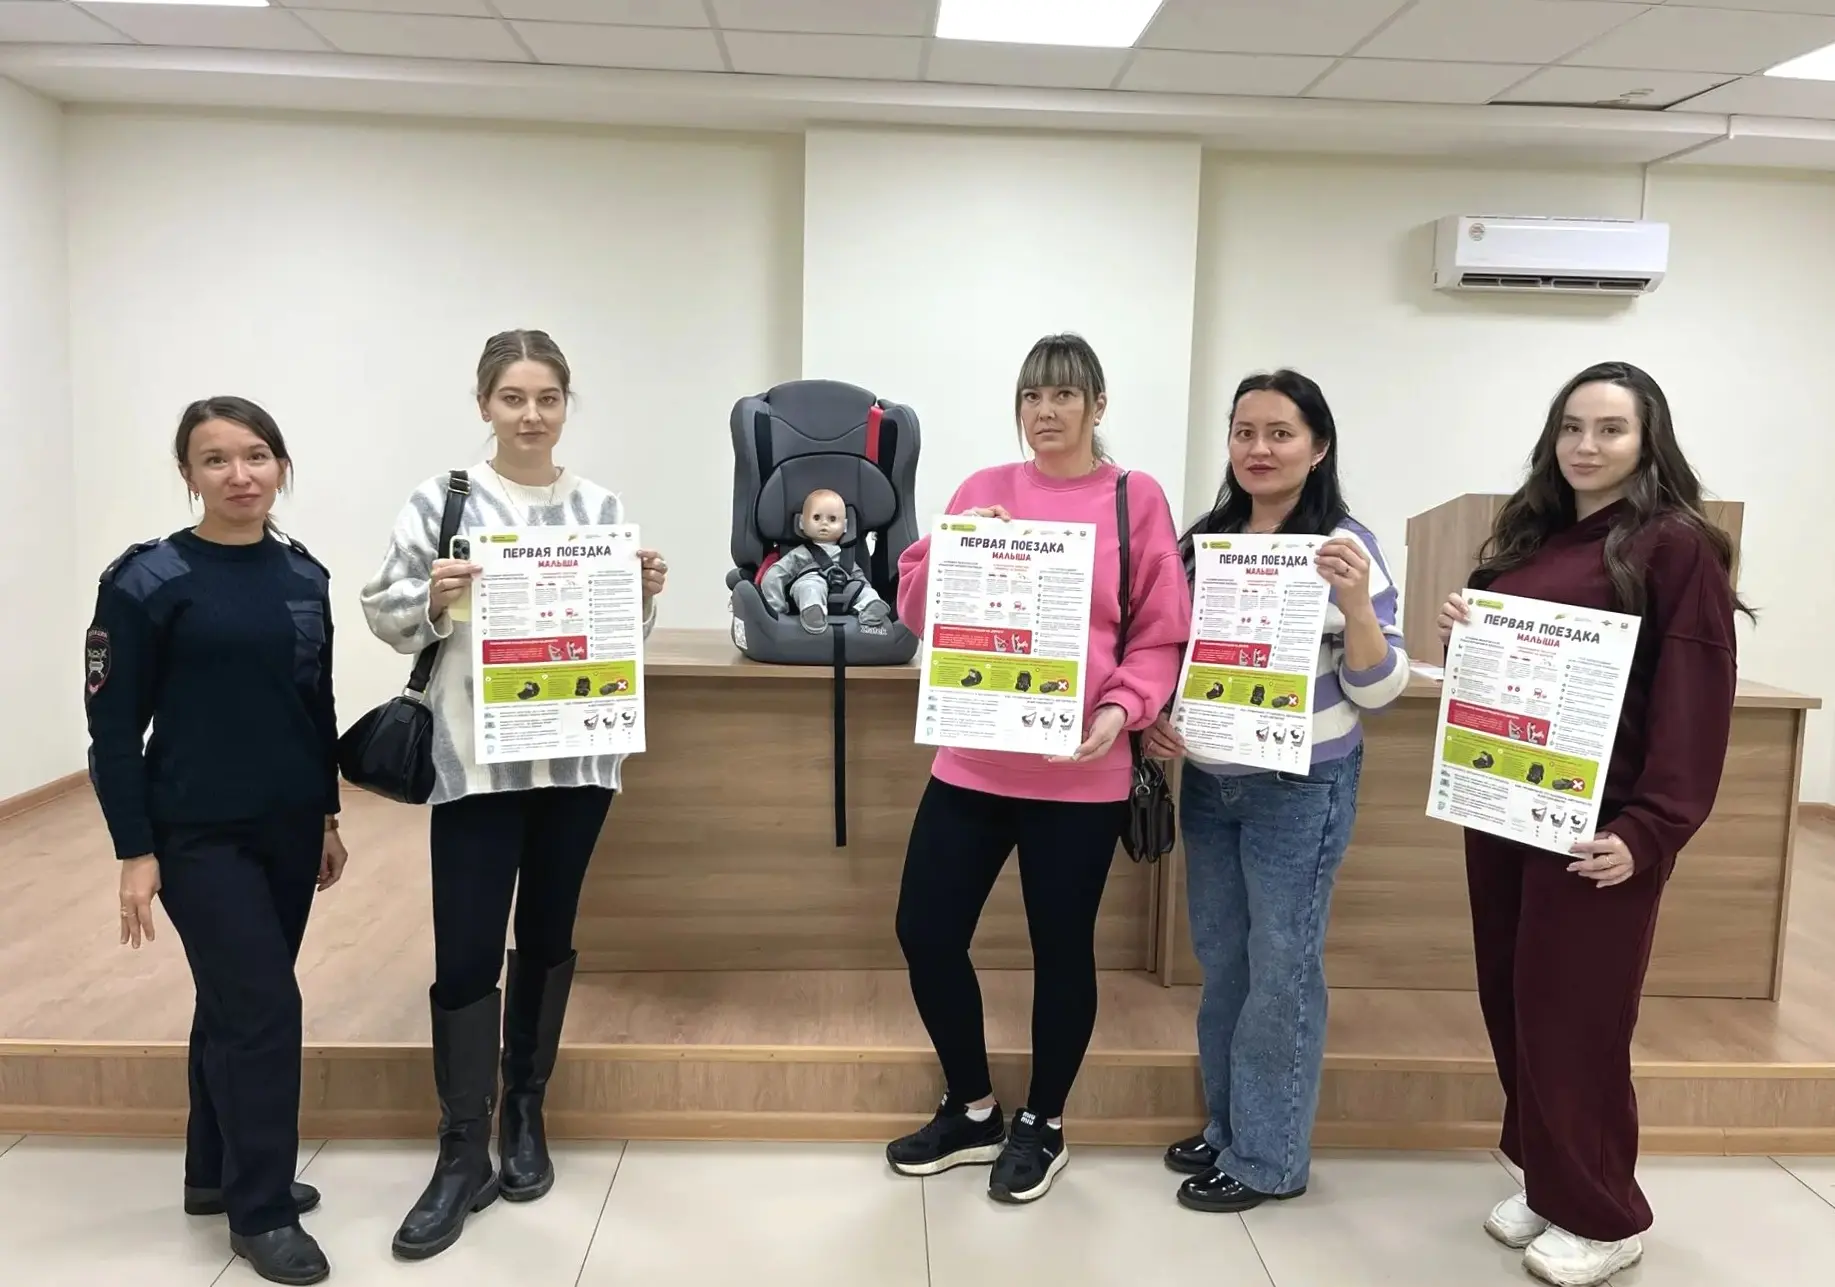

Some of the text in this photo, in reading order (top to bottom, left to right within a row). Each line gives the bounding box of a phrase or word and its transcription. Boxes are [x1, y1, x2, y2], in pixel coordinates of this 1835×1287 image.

[503, 545, 612, 558] ПЕРВАЯ ПОЕЗДКА
[960, 537, 1065, 554] ПЕРВАЯ ПОЕЗДКА
[992, 552, 1031, 561] МАЛЫША
[1219, 554, 1308, 568] ПЕРВАЯ ПОЕЗДКА
[537, 560, 578, 568] МАЛЫША
[1245, 568, 1279, 576] МАЛЫША
[1484, 614, 1601, 644] ПЕРВАЯ ПОЕЗДКА
[1516, 633, 1561, 648] МАЛЫША
